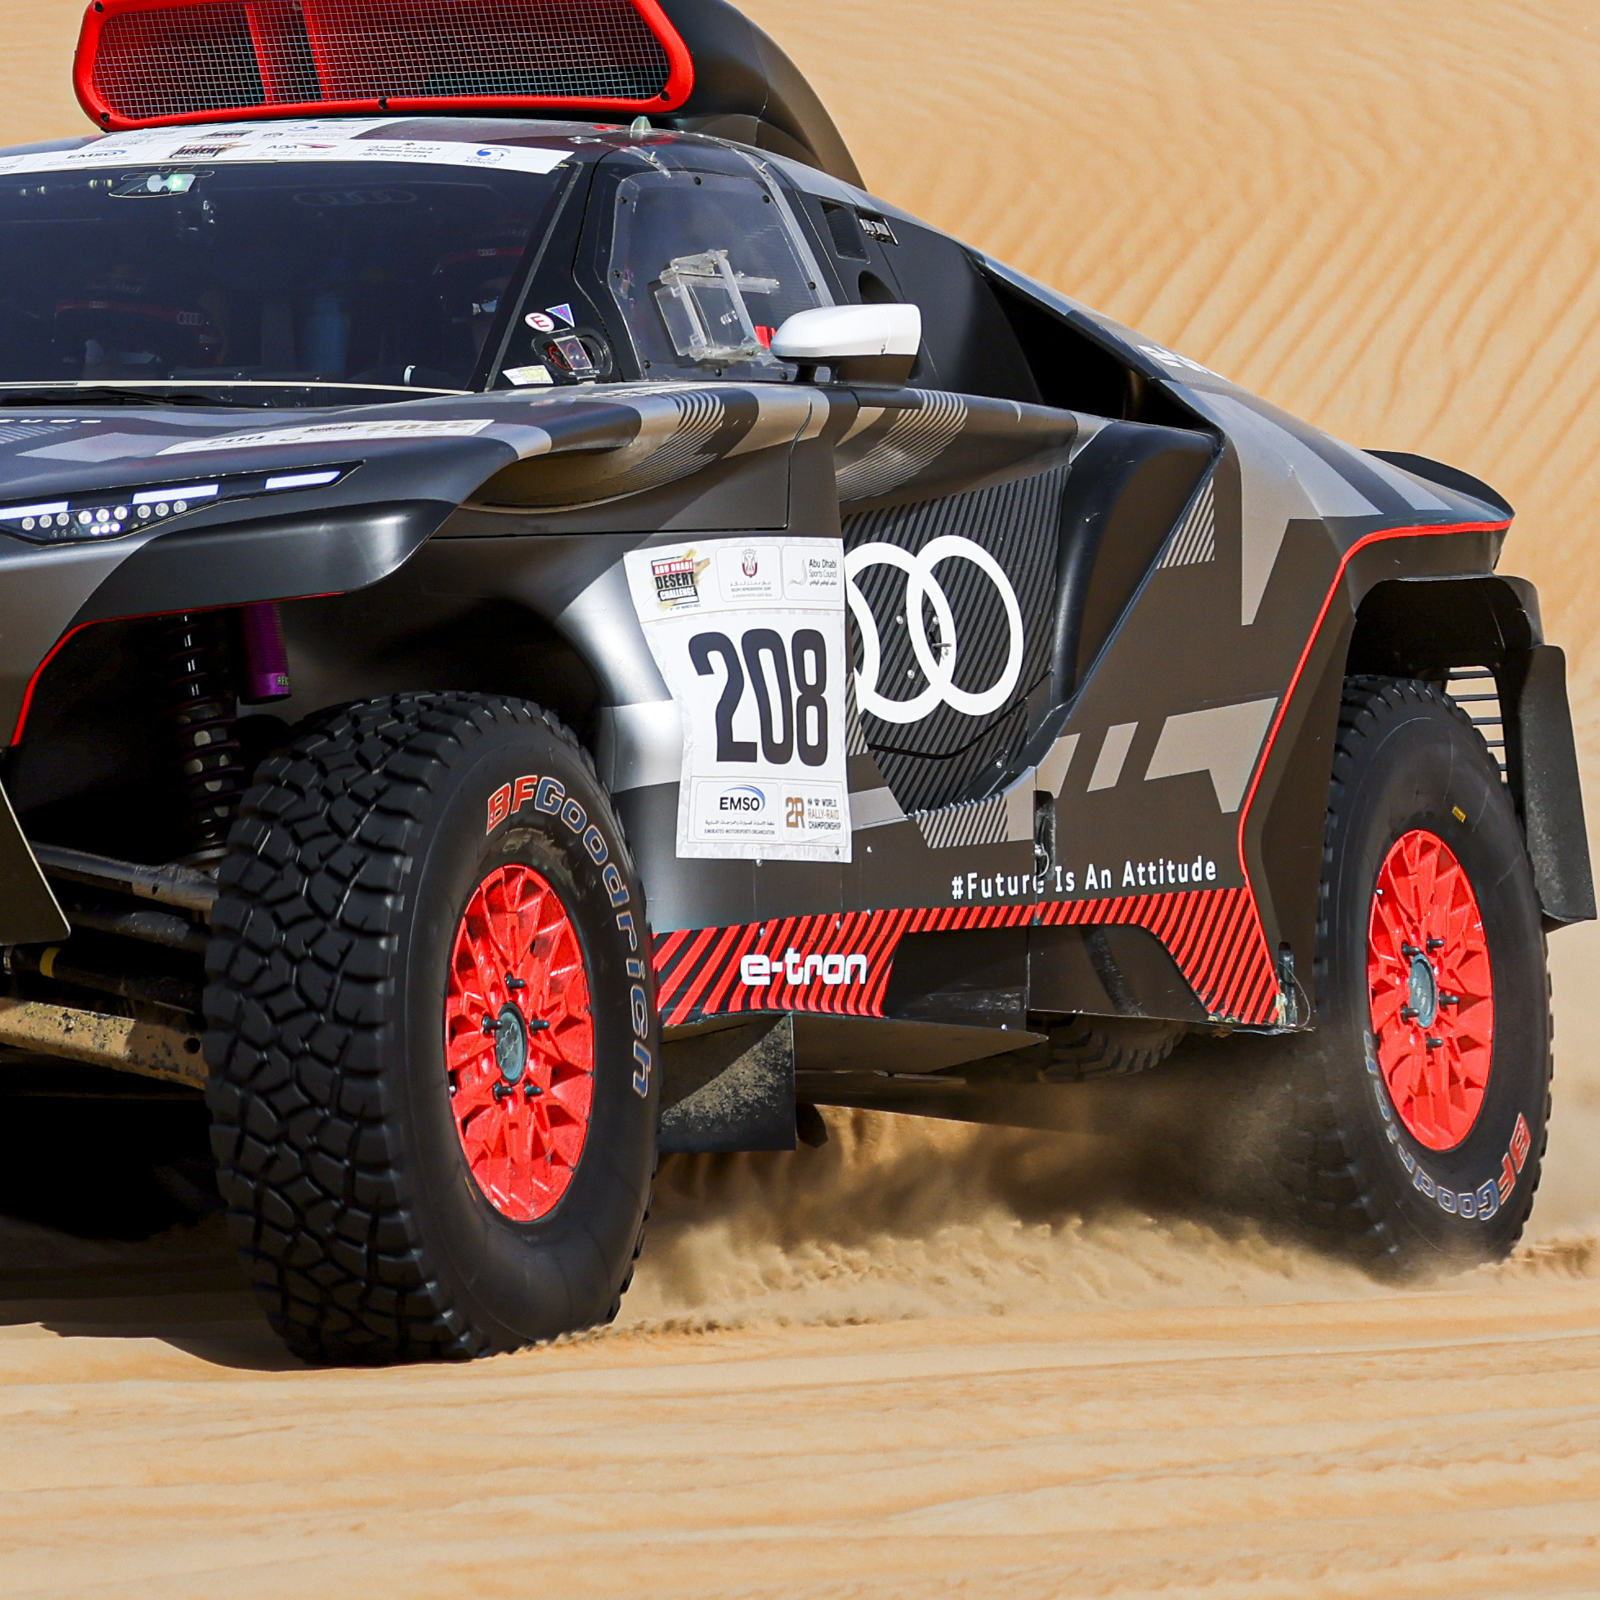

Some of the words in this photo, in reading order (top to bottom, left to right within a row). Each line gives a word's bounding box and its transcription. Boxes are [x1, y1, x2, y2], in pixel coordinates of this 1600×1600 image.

[530, 315, 550, 328] E
[809, 559, 820, 568] Abu
[822, 558, 837, 568] Dhabi
[655, 571, 695, 590] DESERT
[659, 586, 696, 601] CHALLENGE
[688, 628, 828, 766] 208
[719, 796, 760, 811] EMSO
[807, 808, 839, 820] RALLY-RAID
[808, 820, 841, 830] CHAMPIONSHIP
[951, 872, 1044, 899] #Future
[1055, 865, 1076, 893] Is
[1084, 863, 1112, 891] An
[1122, 855, 1217, 888] Attitude
[486, 775, 651, 1098] BFGoodrich
[740, 947, 867, 985] e-tron
